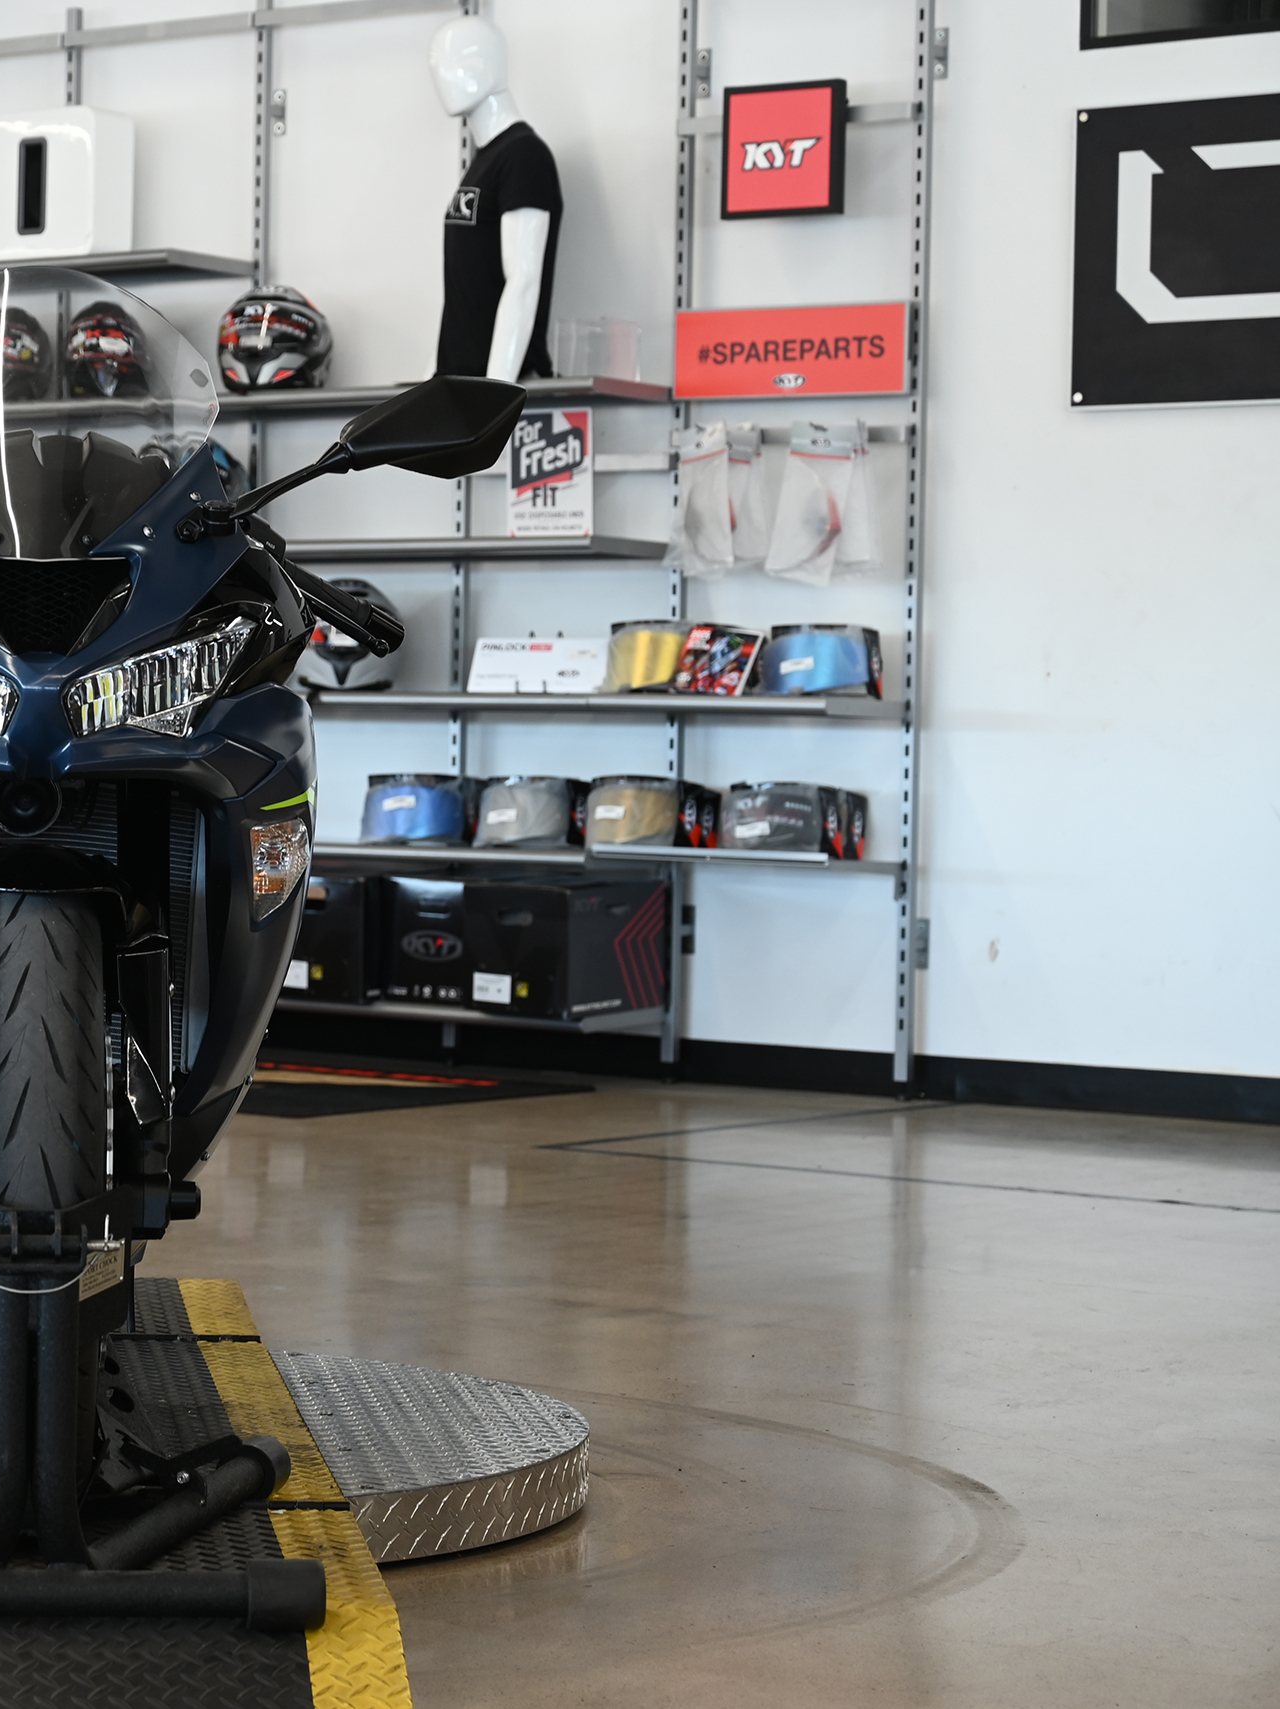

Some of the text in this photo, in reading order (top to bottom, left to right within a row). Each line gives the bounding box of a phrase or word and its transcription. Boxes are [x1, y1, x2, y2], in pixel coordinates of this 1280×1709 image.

[741, 136, 823, 172] KYT
[698, 335, 886, 365] #SPAREPARTS
[514, 420, 543, 447] For
[520, 434, 582, 479] Fresh
[405, 936, 460, 957] KYT
